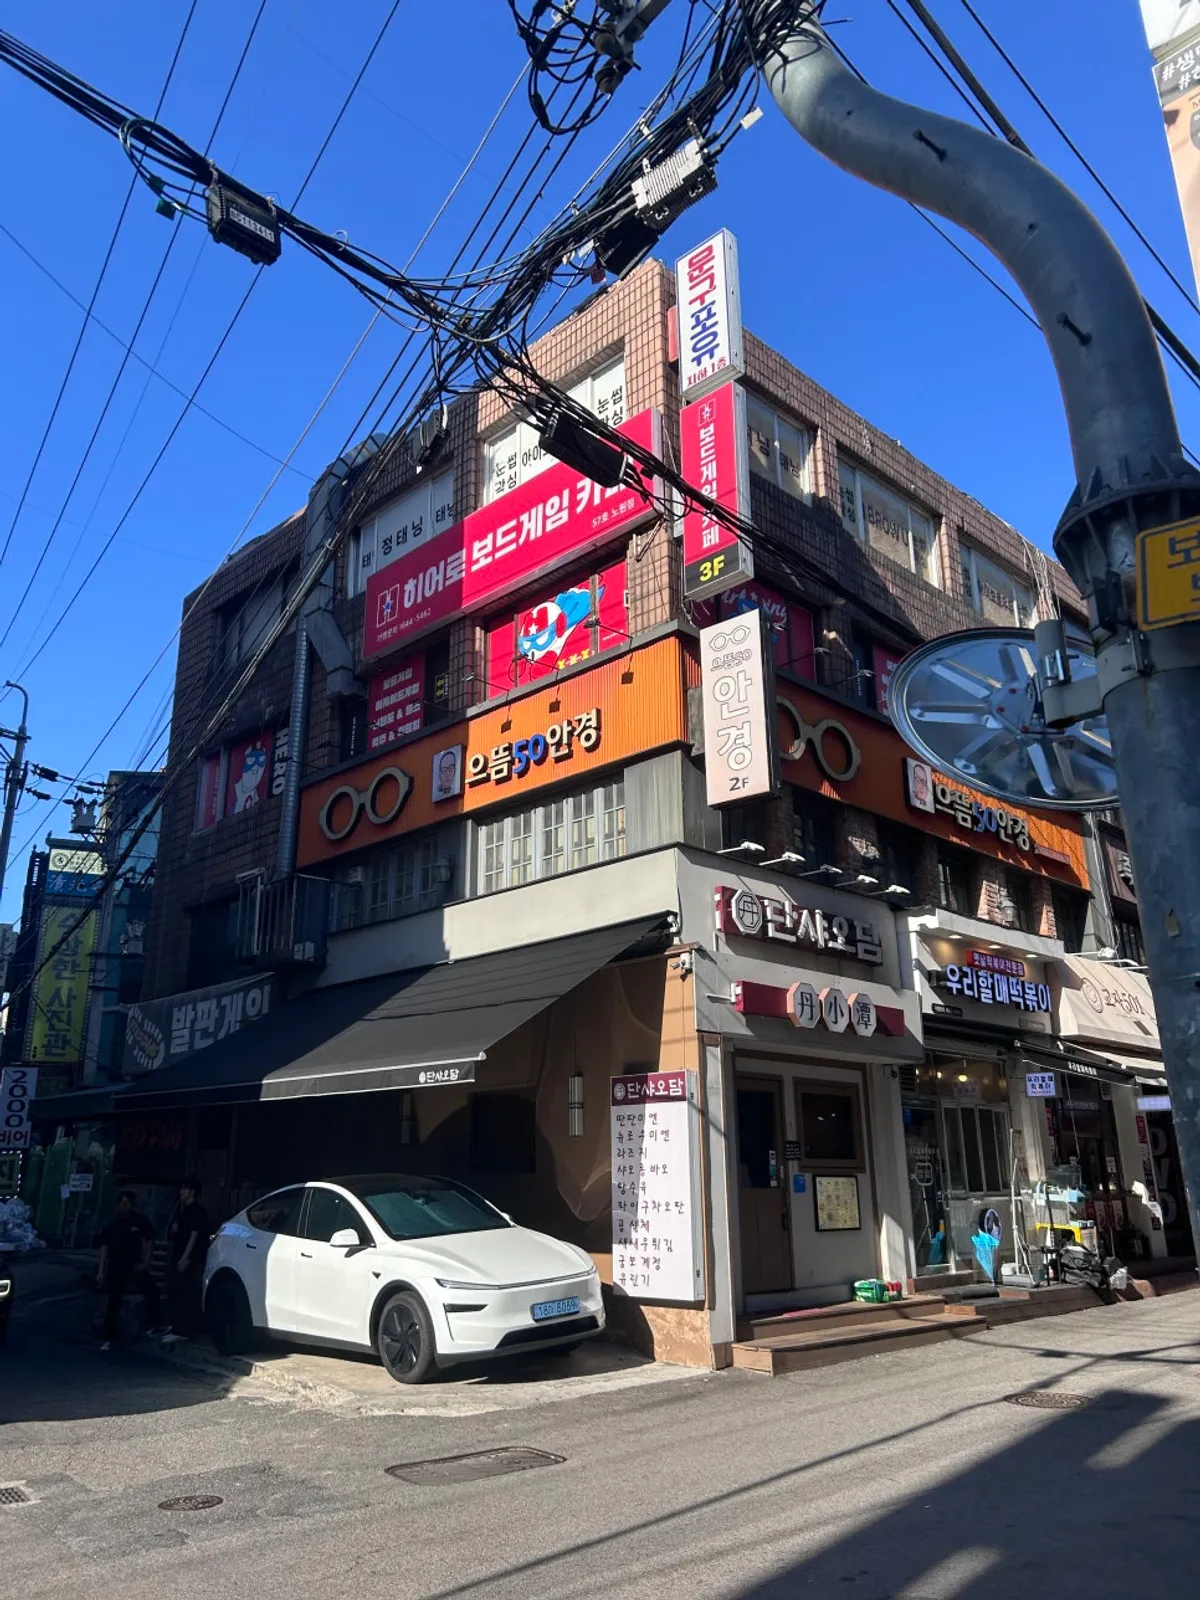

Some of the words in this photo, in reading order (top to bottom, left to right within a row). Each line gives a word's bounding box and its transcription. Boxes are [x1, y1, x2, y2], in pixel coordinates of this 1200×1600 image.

[687, 245, 720, 367] 문구포유
[687, 367, 707, 387] 지하
[522, 445, 550, 467] 아이
[611, 497, 635, 519] 노원점
[403, 548, 466, 609] 히어로
[471, 488, 569, 572] 보드게임
[700, 554, 725, 582] 3F
[713, 670, 752, 771] 안경
[465, 707, 601, 784] 으뜸50안경
[729, 776, 749, 791] 2F
[936, 783, 1029, 850] 으뜸50안경
[946, 963, 1052, 1013] 우리할매떡볶이
[426, 1068, 460, 1083] 단샤오담
[627, 1078, 684, 1099] 단샤오담
[6, 1070, 28, 1128] 2000
[618, 1272, 650, 1288] 유린기
